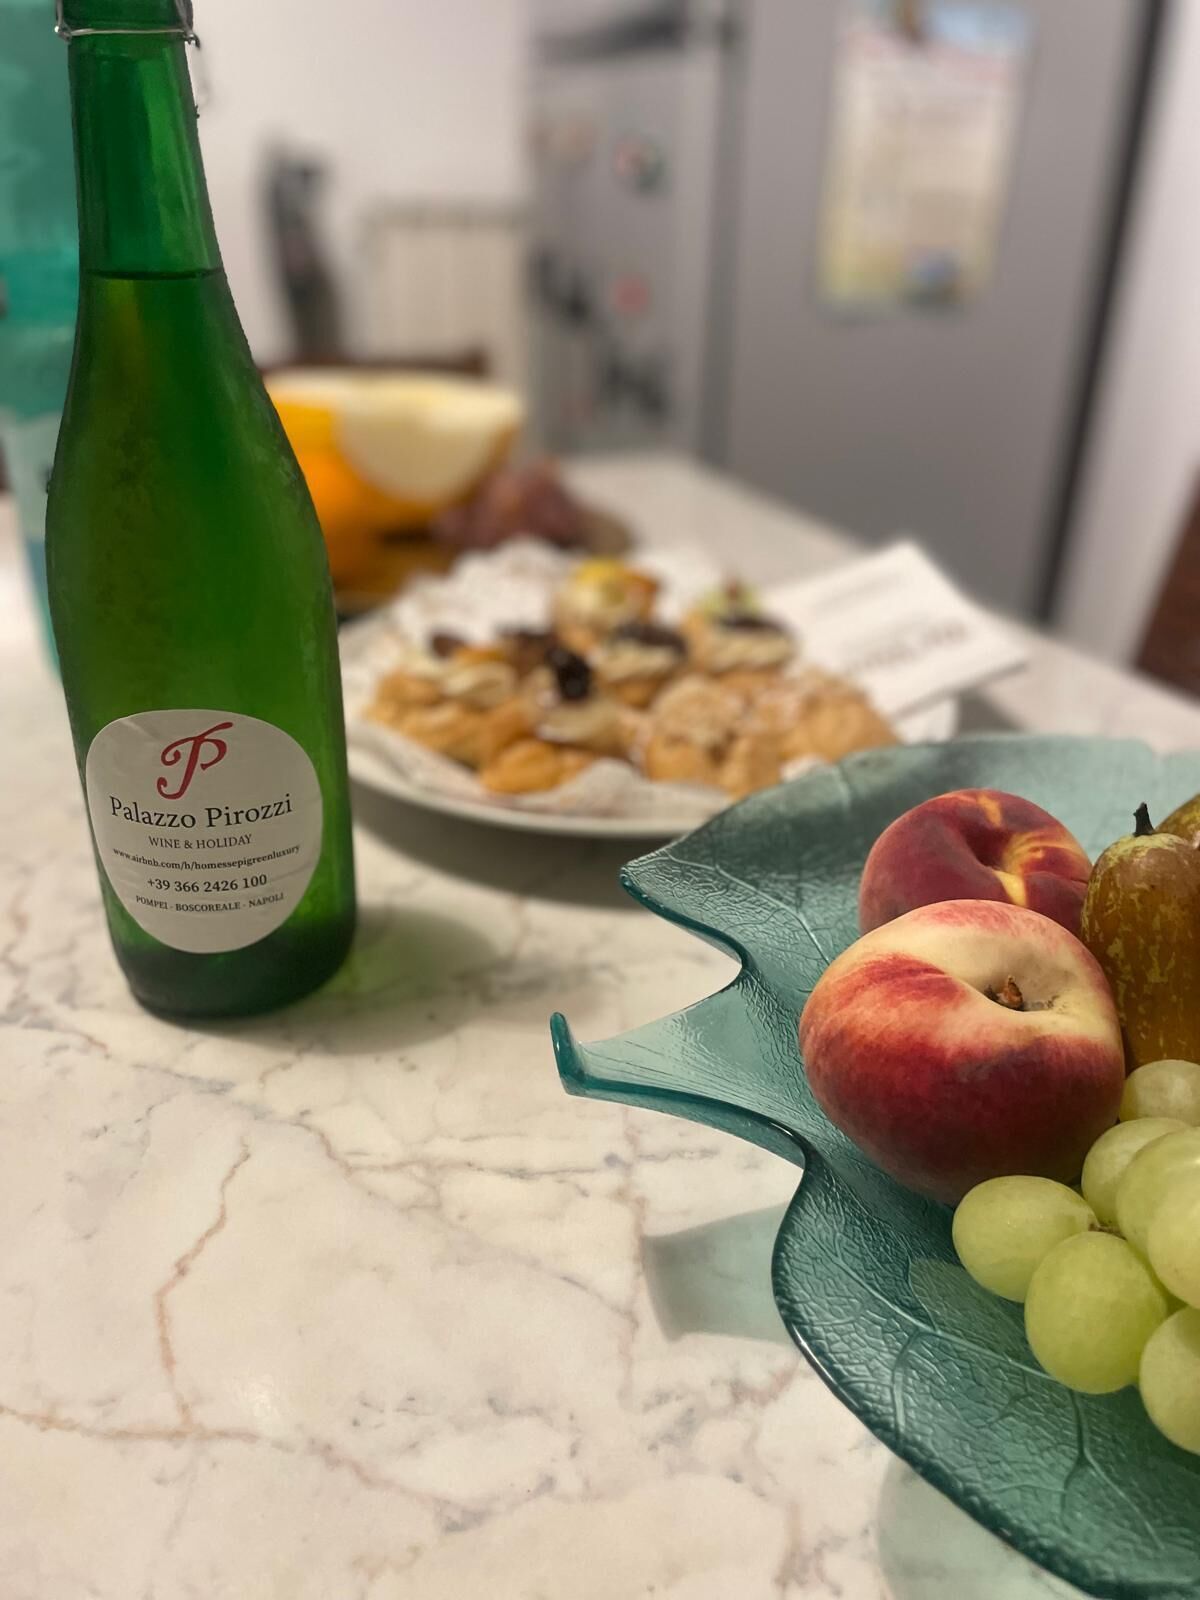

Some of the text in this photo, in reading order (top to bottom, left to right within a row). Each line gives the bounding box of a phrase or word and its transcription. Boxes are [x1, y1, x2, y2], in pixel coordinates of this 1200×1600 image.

[109, 793, 293, 829] Palazzo Pirozzi
[148, 834, 252, 849] WINE & HOLIDAY
[147, 874, 268, 893] +39 366 2426 100
[135, 894, 168, 910] POMPEI
[175, 902, 241, 912] BOSCOREALE
[248, 892, 284, 908] NAPOLI
